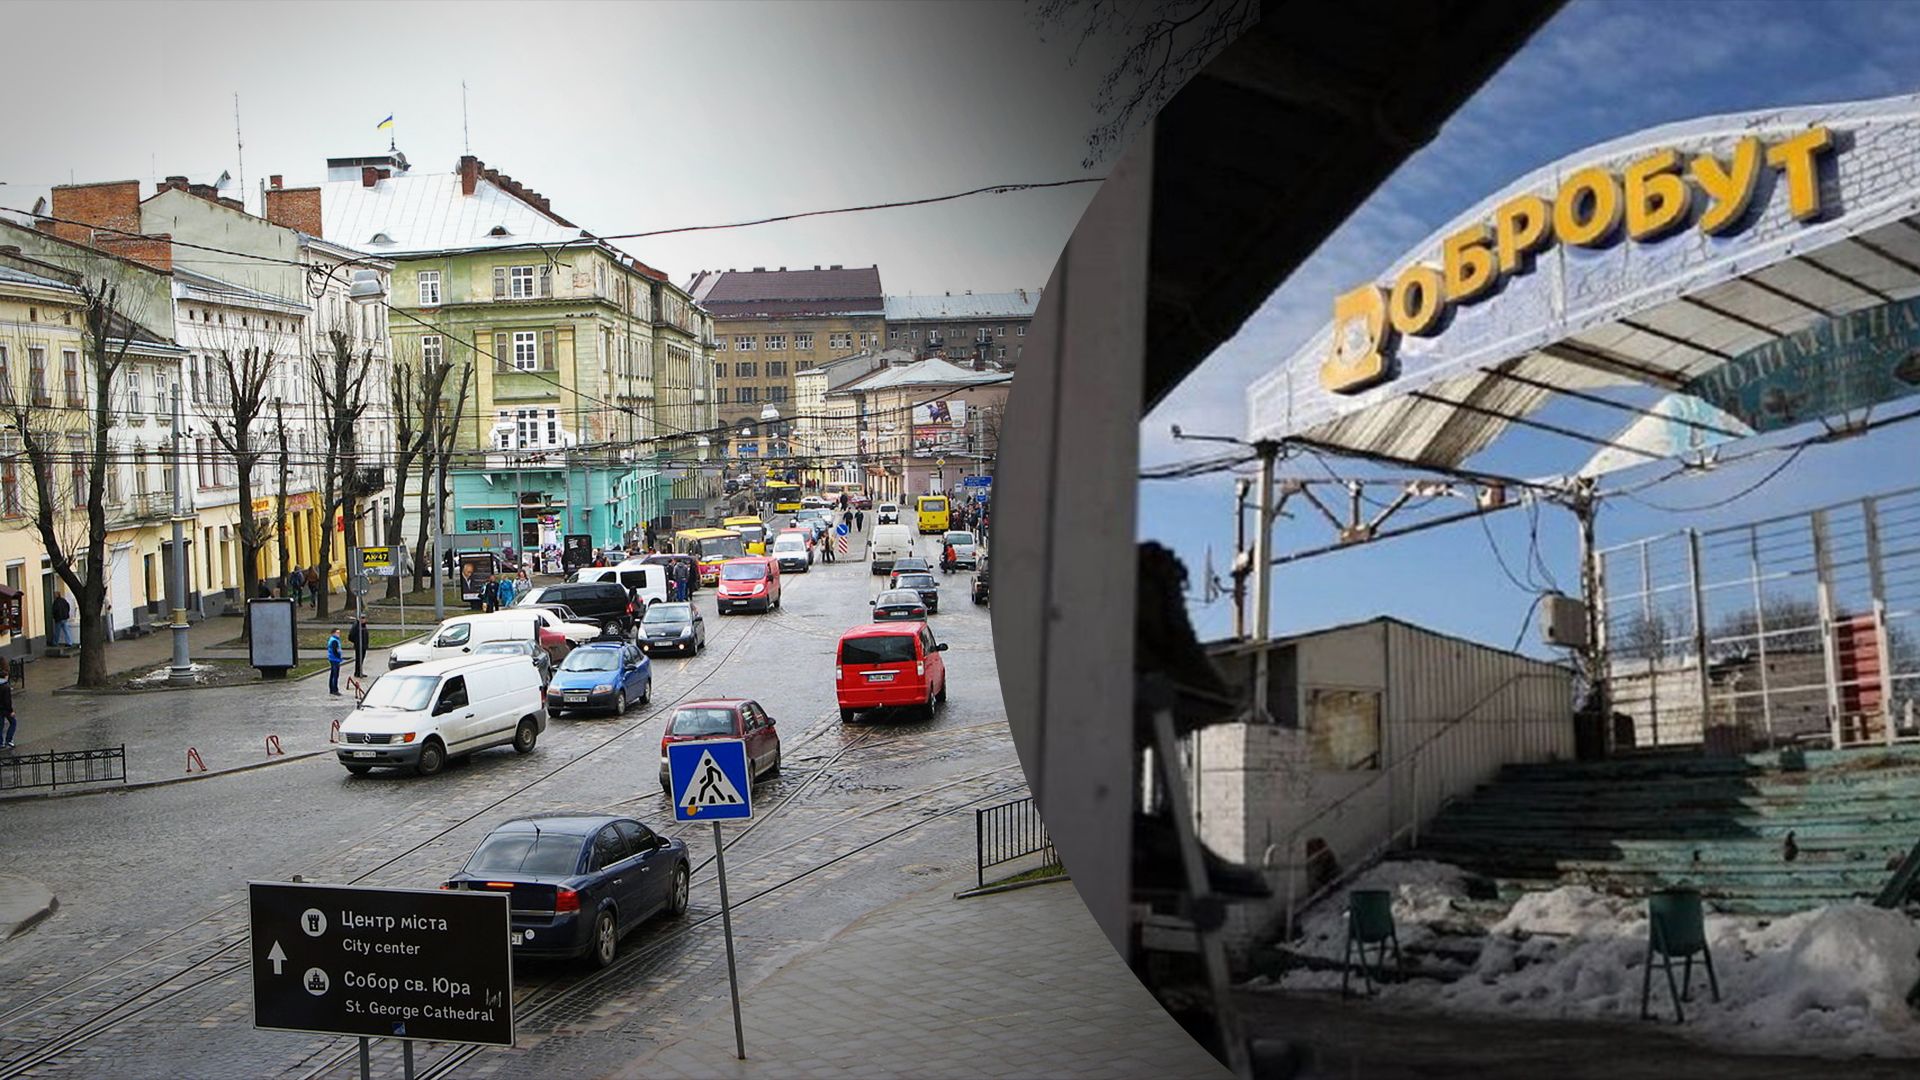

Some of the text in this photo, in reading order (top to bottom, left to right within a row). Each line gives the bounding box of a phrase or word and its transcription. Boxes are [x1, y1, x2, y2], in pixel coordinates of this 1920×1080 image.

[1319, 126, 1834, 394] ДОБРОБУТ
[341, 910, 448, 932] Центр міста
[342, 938, 421, 955] City center
[344, 970, 399, 993] Собор
[404, 978, 428, 992] св.
[432, 977, 471, 998] Юра
[345, 999, 495, 1022] St. George Cathedral
